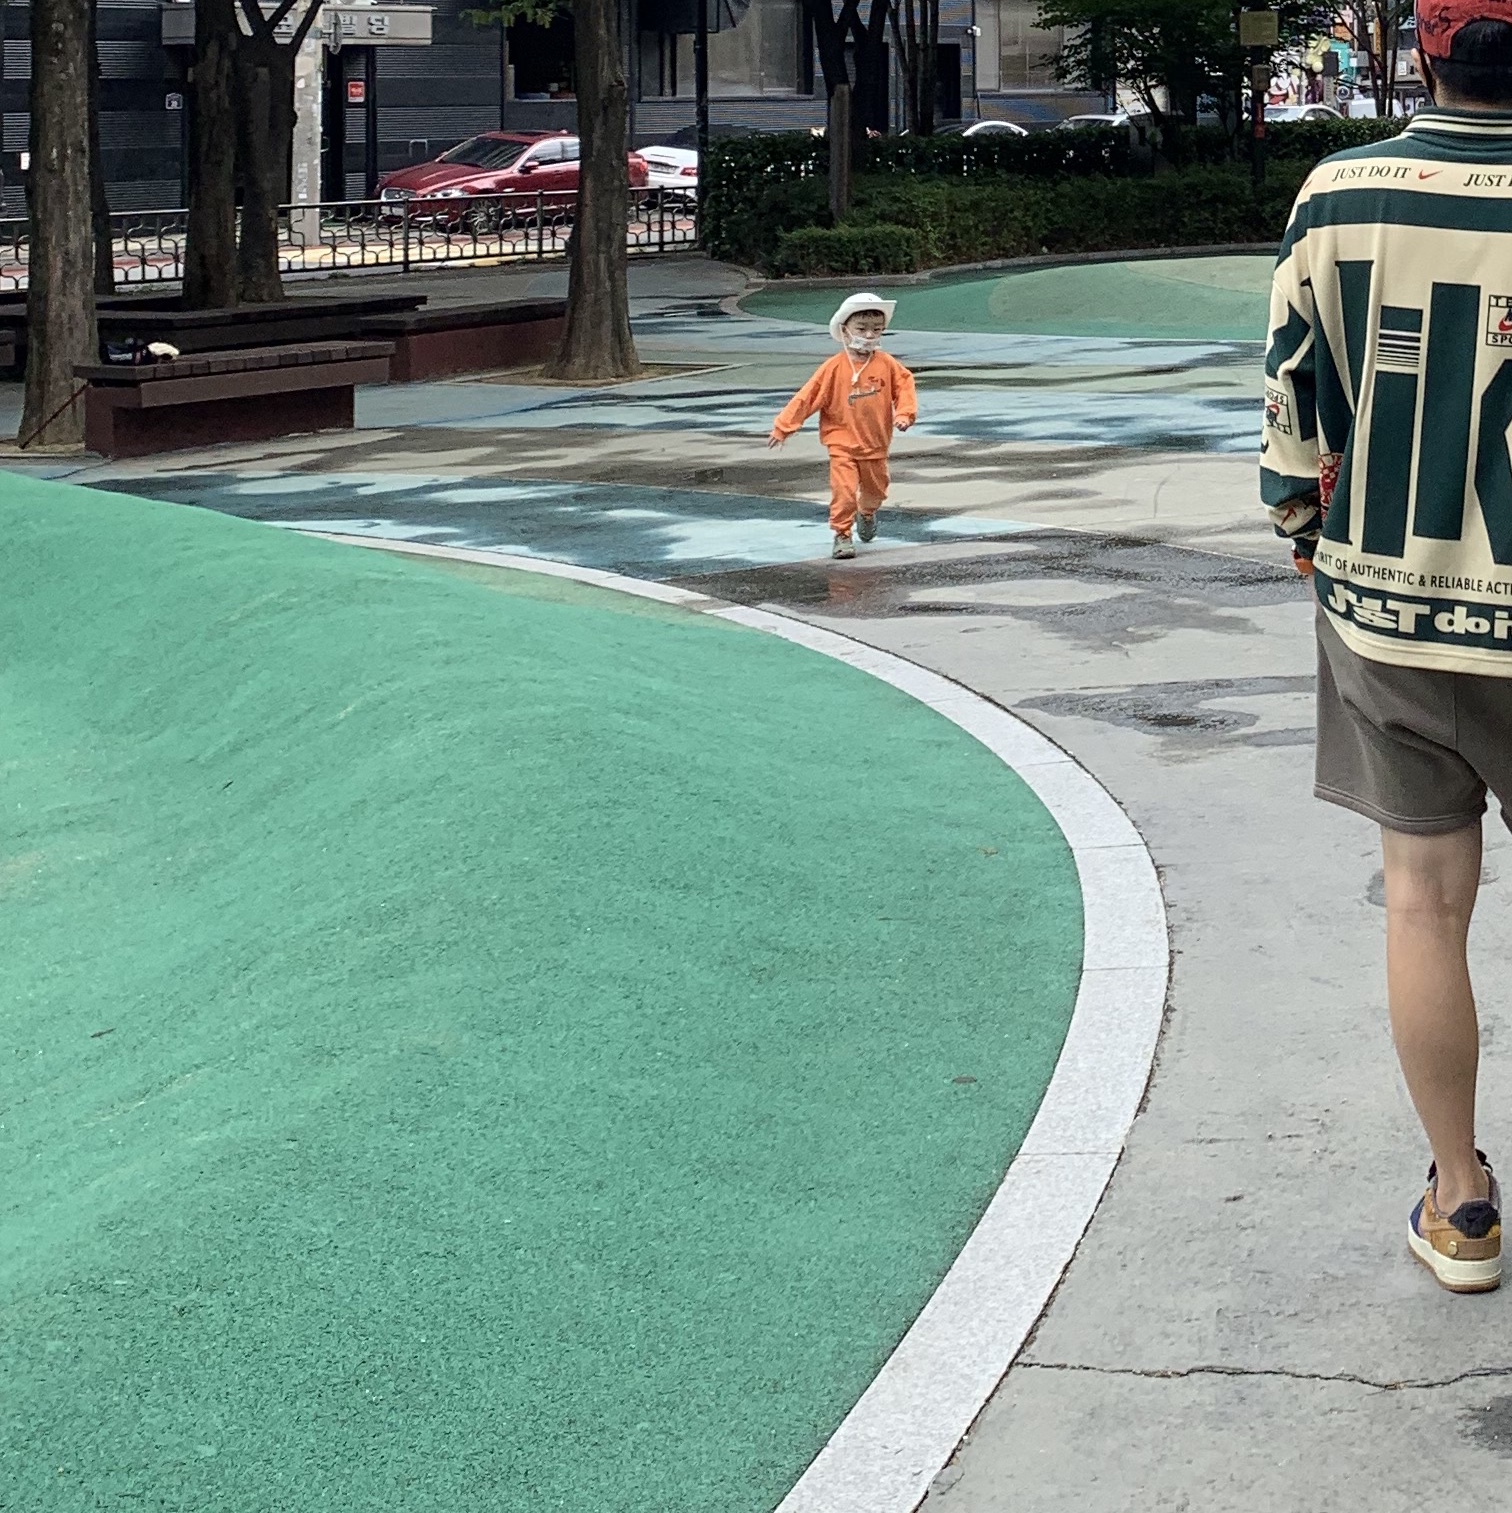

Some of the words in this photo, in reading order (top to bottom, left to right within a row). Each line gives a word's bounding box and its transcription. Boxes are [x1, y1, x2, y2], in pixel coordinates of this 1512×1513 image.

[1332, 166, 1368, 182] JUST
[1368, 166, 1391, 178] DO
[1394, 167, 1412, 179] IT
[1463, 173, 1507, 188] JUST
[1335, 558, 1348, 572] OF
[1350, 562, 1415, 586] AUTHENTIC
[1418, 574, 1426, 587] &
[1430, 575, 1483, 593] RELIABLE
